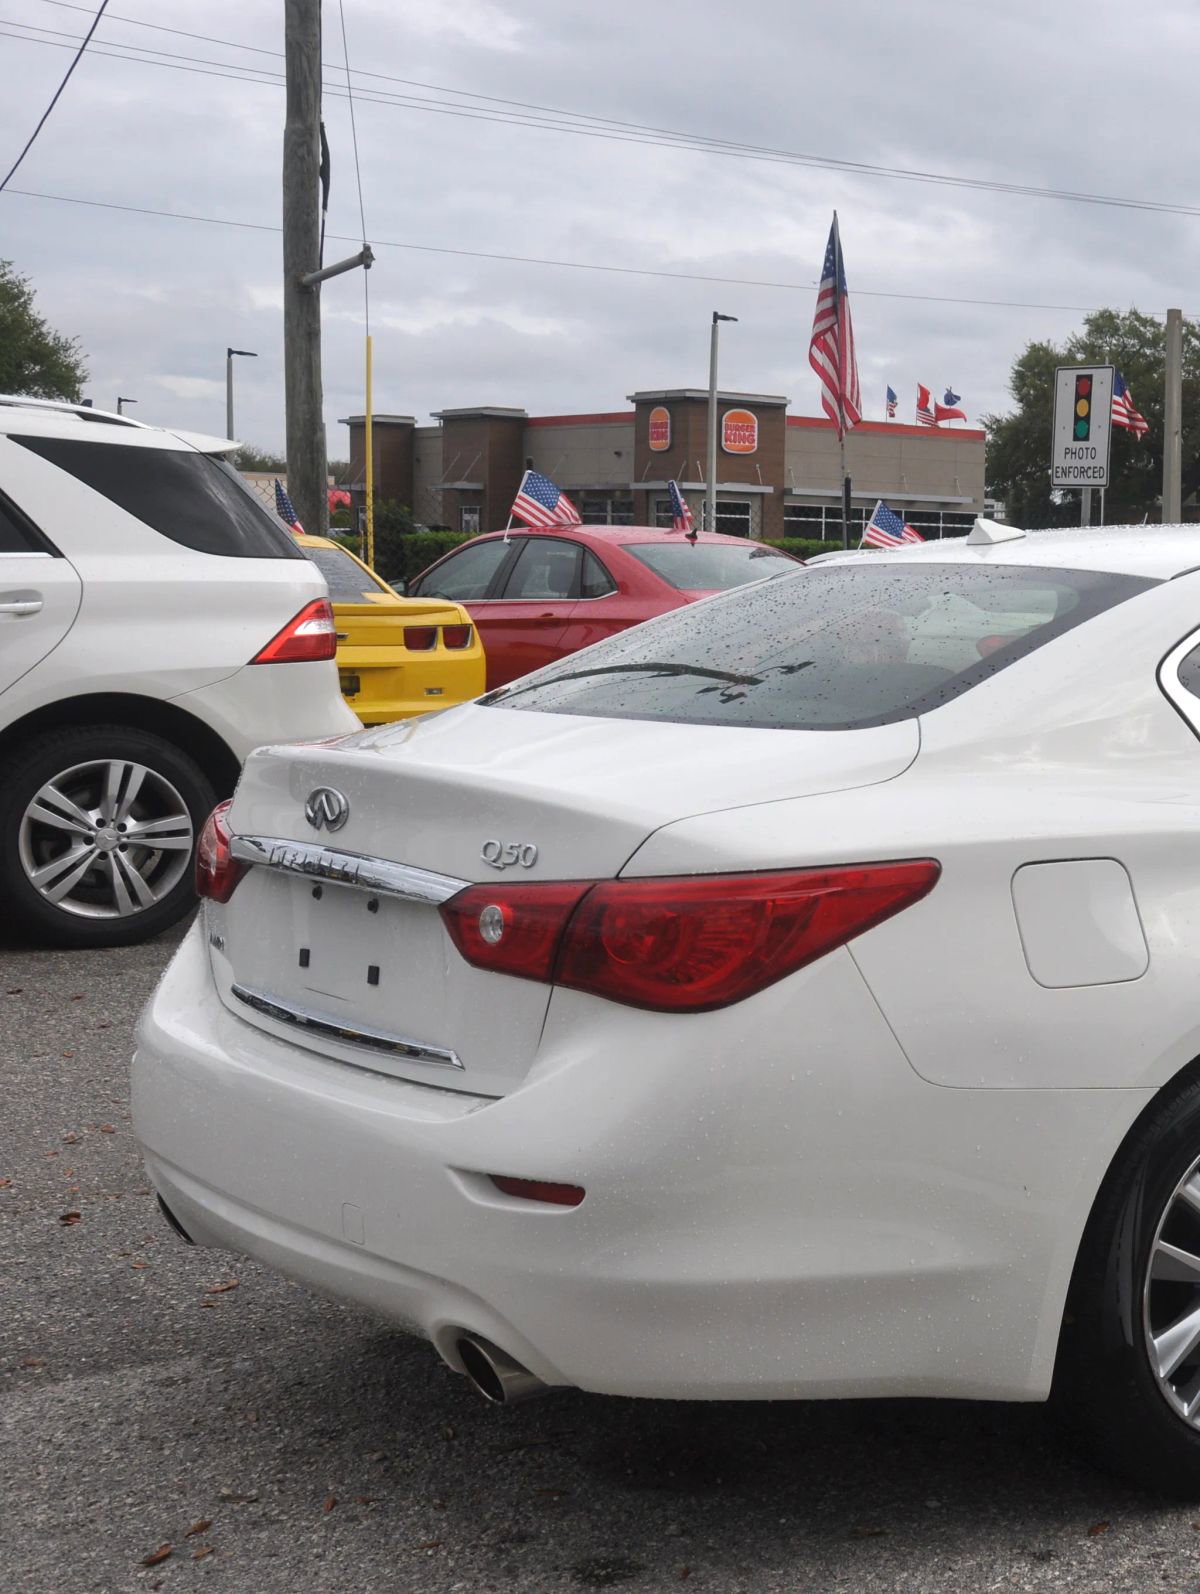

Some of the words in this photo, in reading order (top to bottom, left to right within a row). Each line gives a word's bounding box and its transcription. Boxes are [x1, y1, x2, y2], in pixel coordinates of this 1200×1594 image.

[724, 423, 755, 433] BURGER
[724, 432, 755, 444] KING
[1064, 447, 1097, 460] PHOTO
[1055, 466, 1105, 479] ENFORCED
[480, 839, 538, 872] Q50
